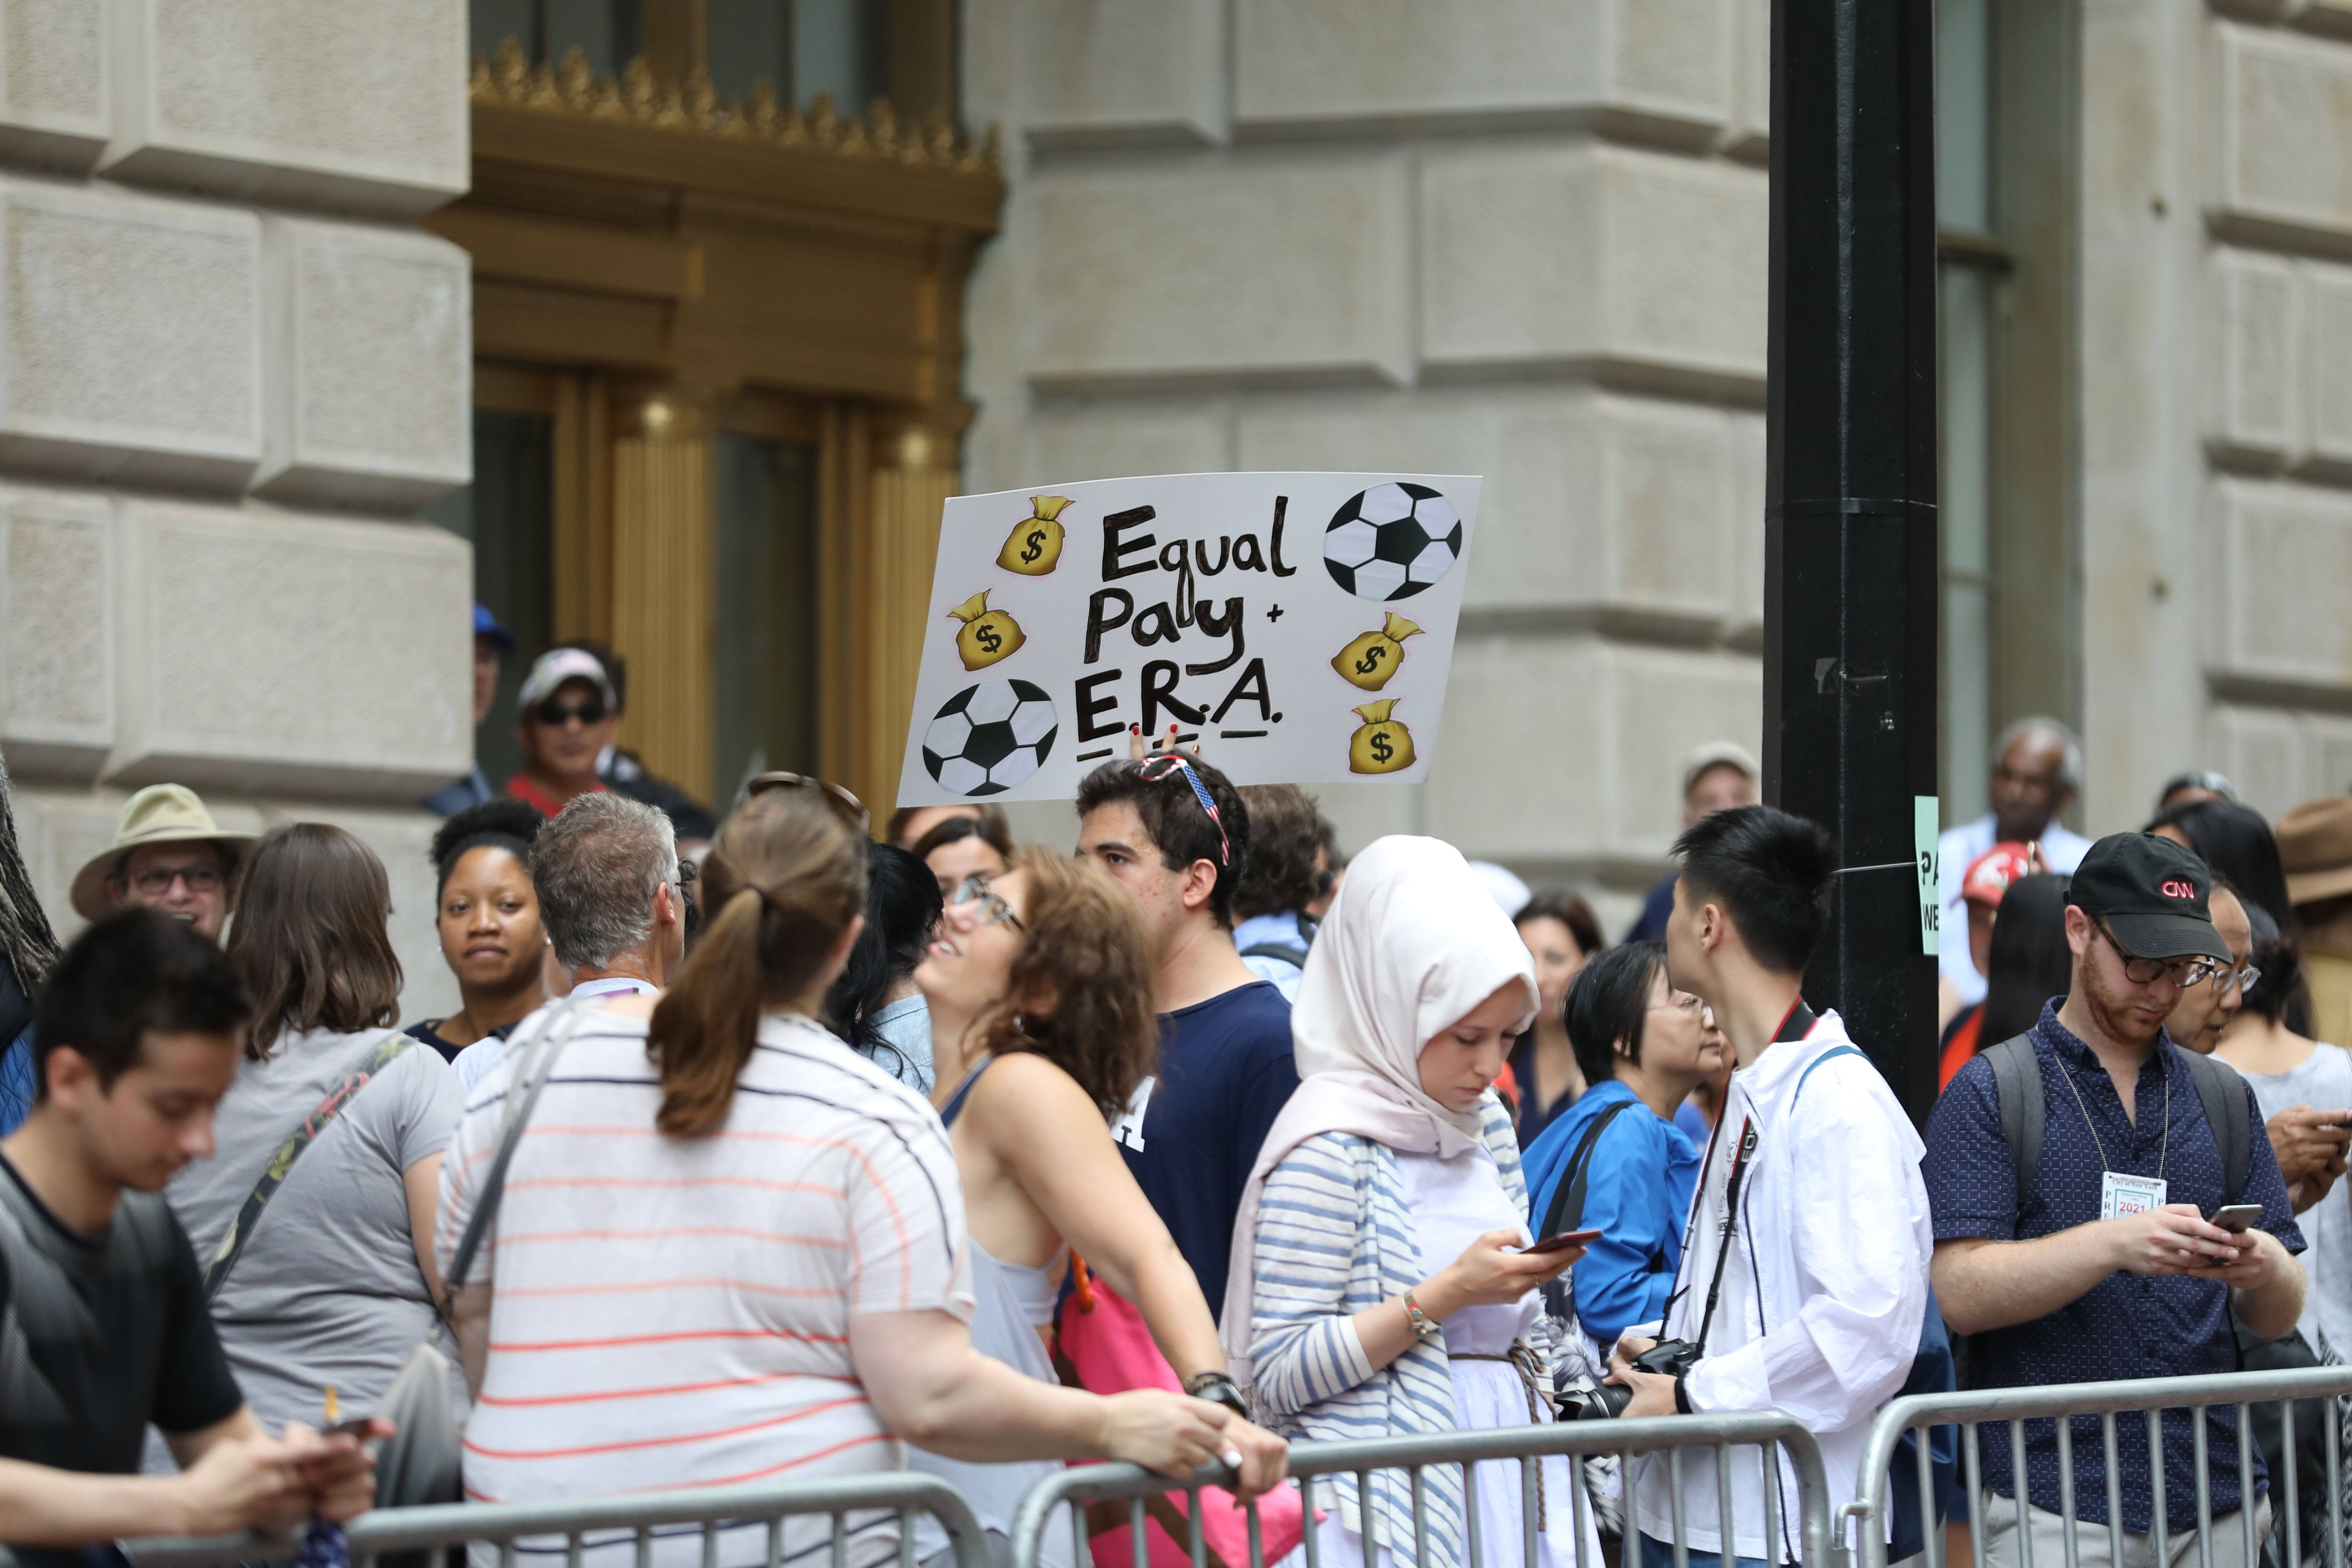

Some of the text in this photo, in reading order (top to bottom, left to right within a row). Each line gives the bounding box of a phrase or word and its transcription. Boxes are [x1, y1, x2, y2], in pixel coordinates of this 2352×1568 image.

[1103, 495, 1296, 628] Equal
[1084, 588, 1244, 675] Pay
[1075, 658, 1283, 743] E.R.A.
[2162, 880, 2195, 899] CNN
[2120, 1202, 2145, 1213] 2021
